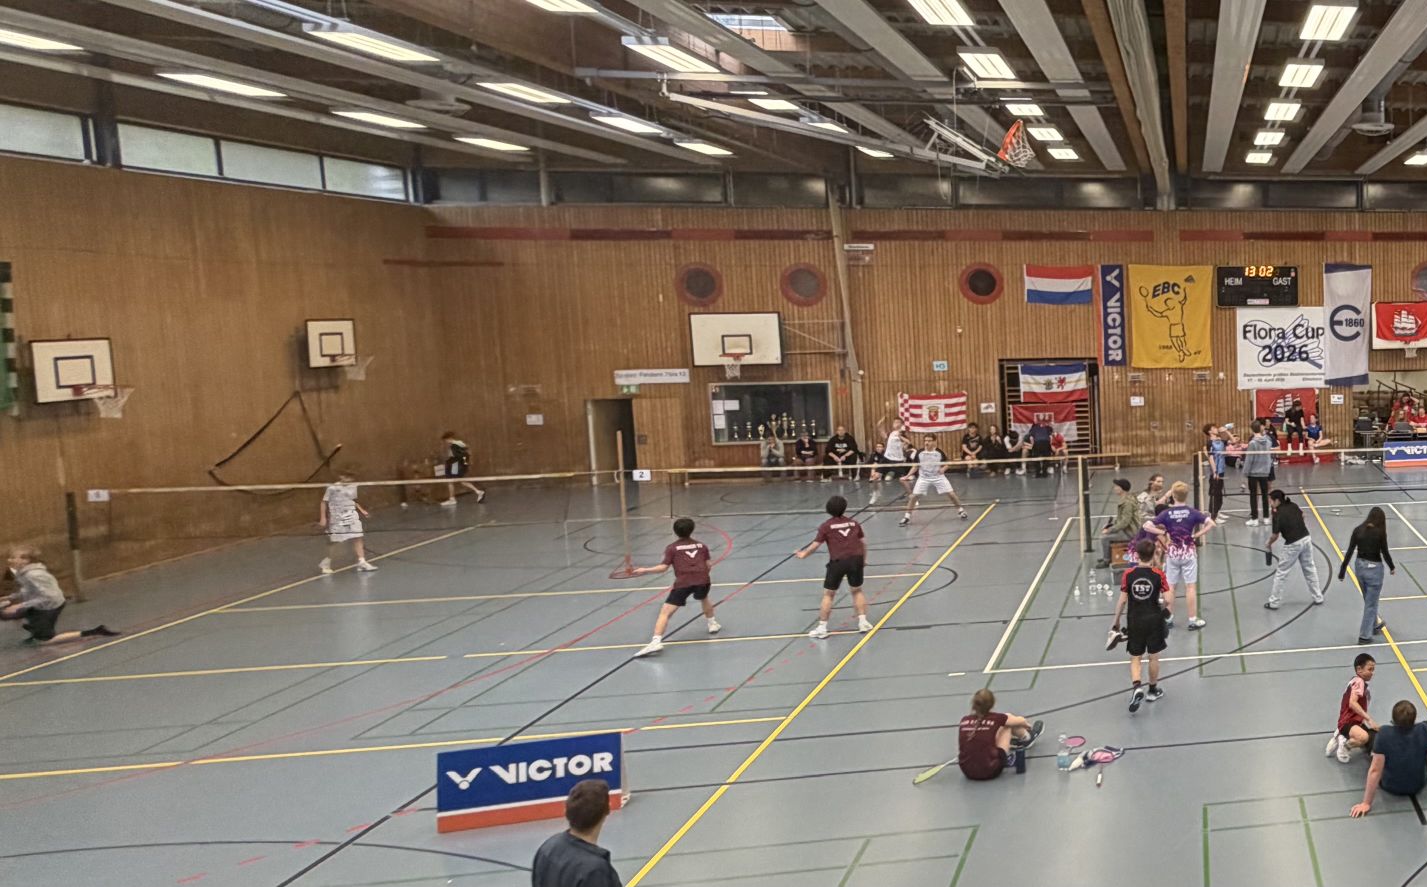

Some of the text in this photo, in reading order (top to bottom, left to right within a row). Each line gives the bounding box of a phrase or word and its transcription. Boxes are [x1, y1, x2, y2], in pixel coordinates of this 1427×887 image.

[1151, 281, 1181, 299] EBC
[1224, 277, 1243, 286] HEIM
[1272, 277, 1292, 286] GAST
[1106, 291, 1122, 361] VICTOR
[1344, 318, 1365, 328] 1860
[1242, 324, 1286, 341] Flora
[1261, 344, 1310, 363] 2026
[488, 751, 614, 785] VICTOR
